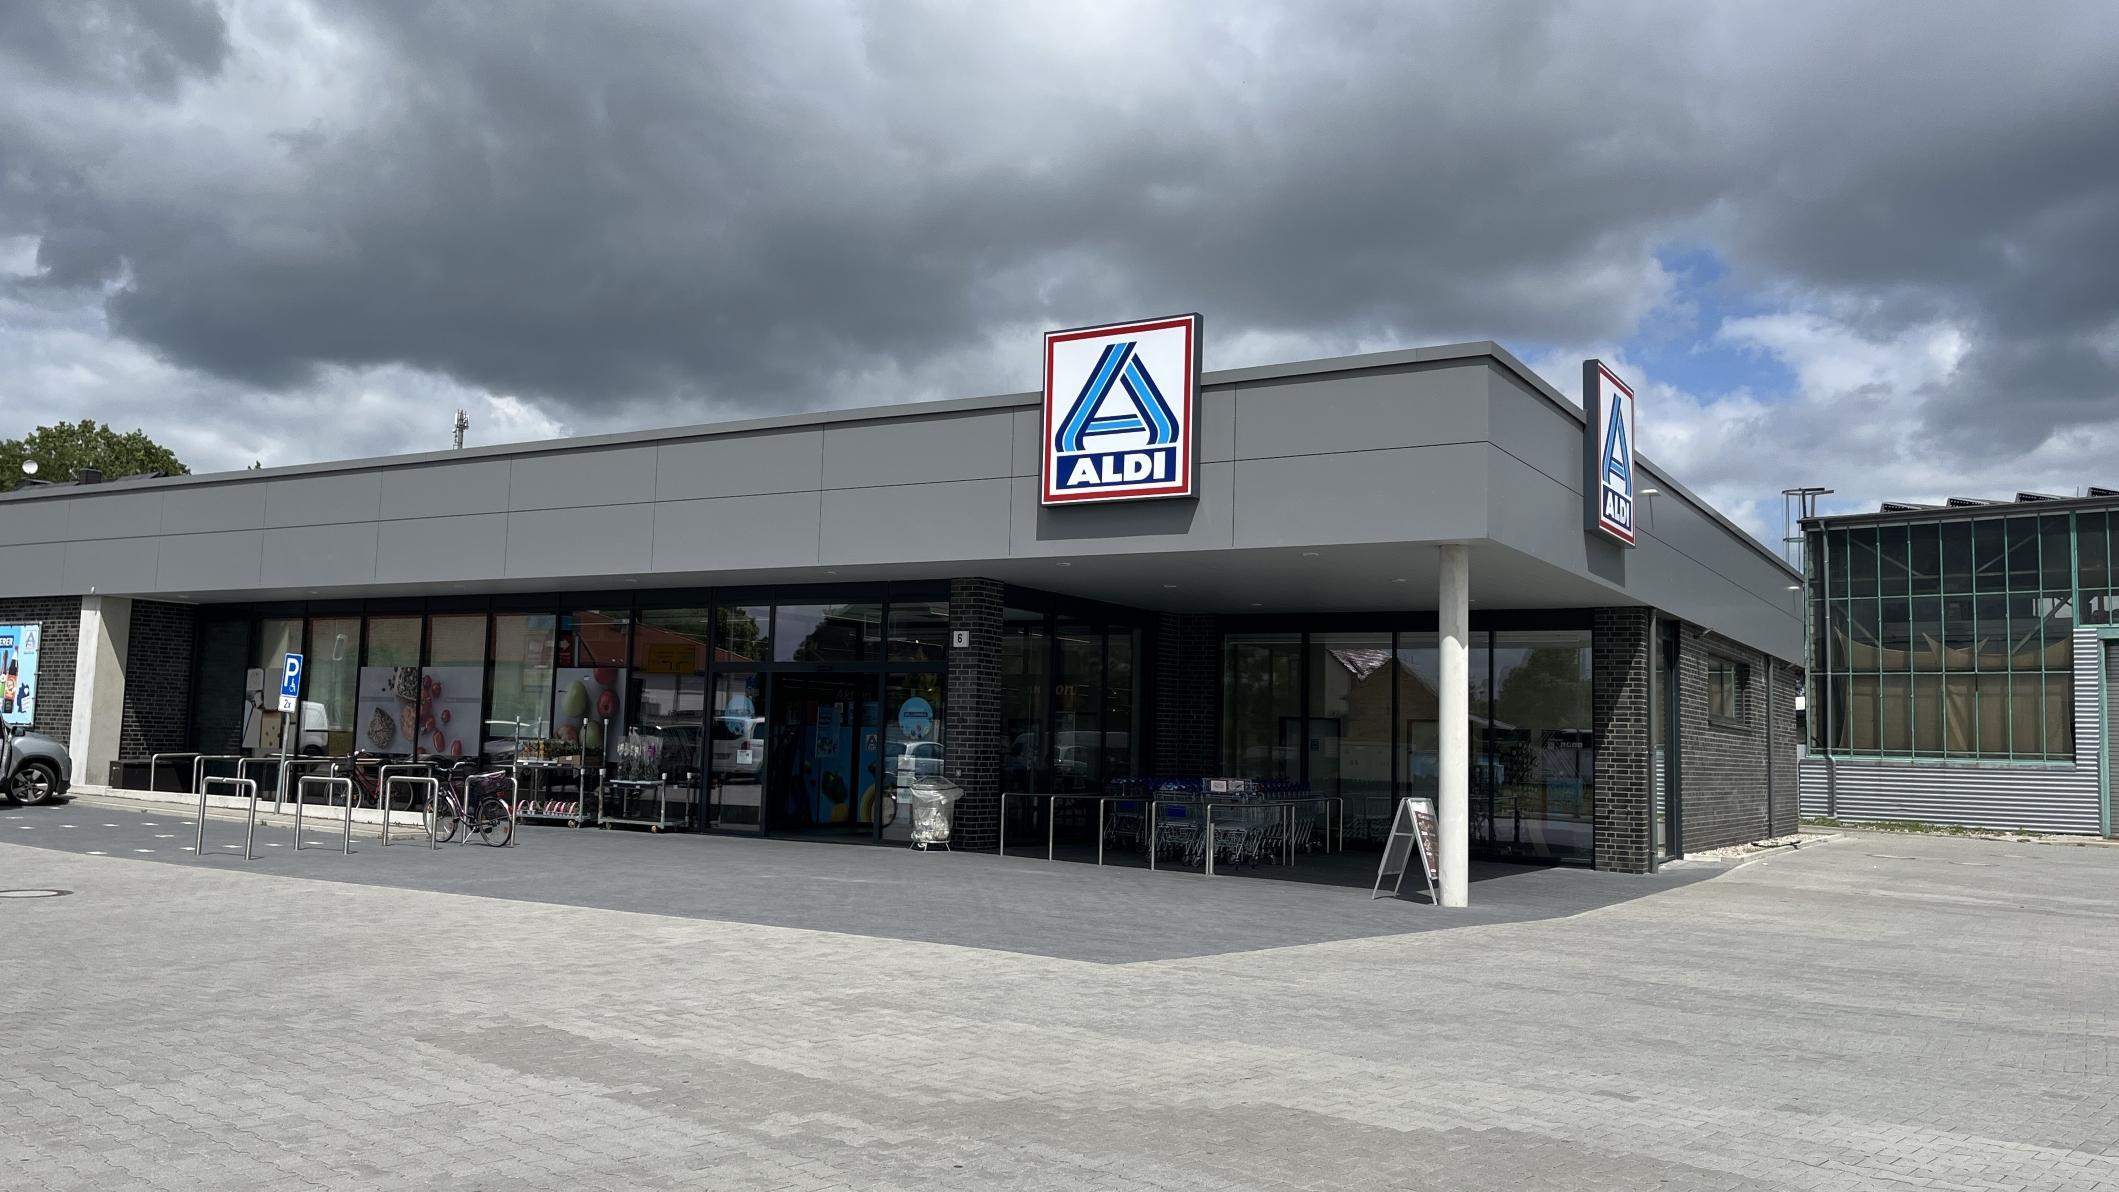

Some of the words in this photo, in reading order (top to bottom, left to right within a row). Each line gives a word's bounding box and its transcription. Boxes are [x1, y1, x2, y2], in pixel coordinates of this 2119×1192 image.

[1066, 451, 1166, 486] ALDI
[1605, 491, 1631, 528] ALDI
[957, 633, 963, 643] 6
[284, 658, 299, 687] P
